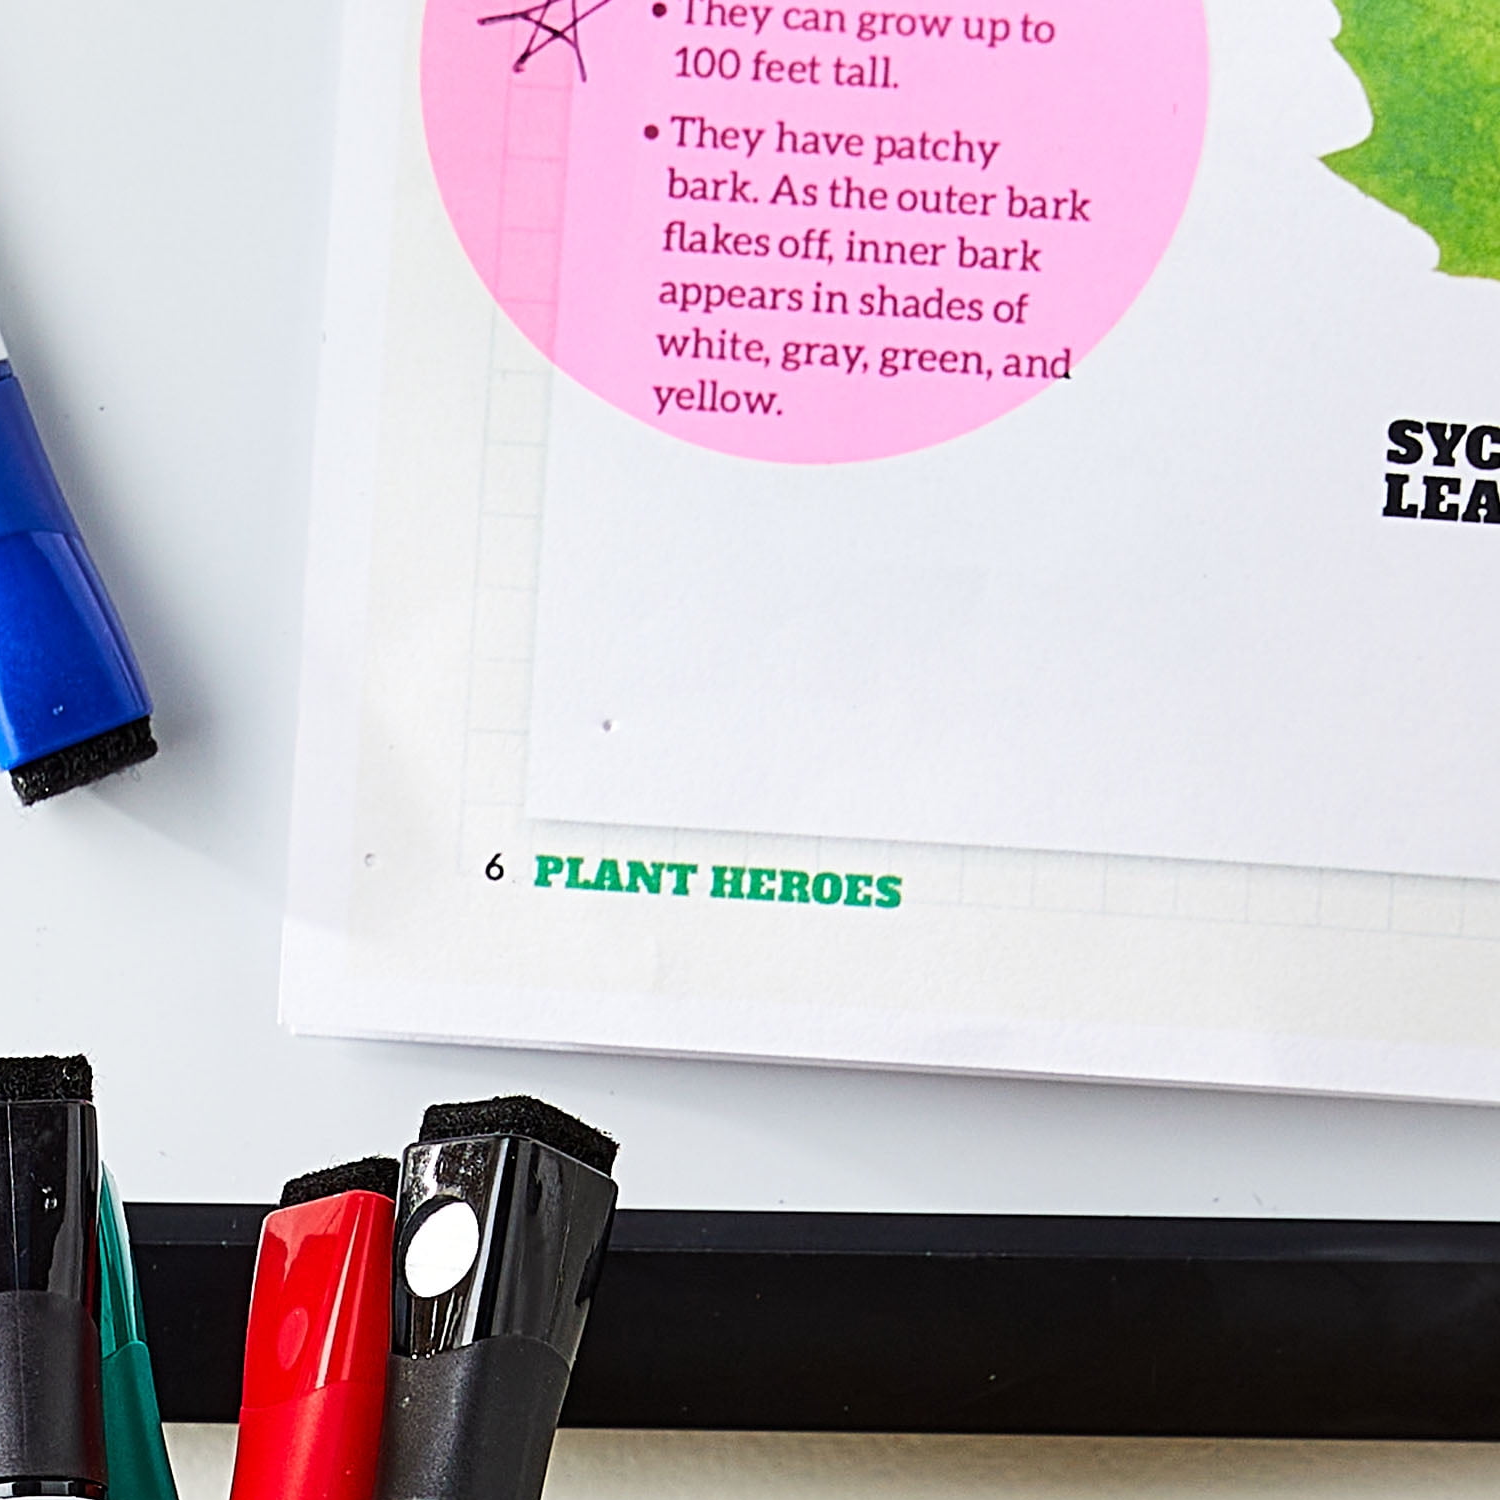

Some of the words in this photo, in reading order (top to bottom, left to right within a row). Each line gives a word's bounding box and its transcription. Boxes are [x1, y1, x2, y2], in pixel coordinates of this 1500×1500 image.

[783, 6, 846, 33] can
[856, 13, 951, 40] grow
[963, 17, 1010, 47] up
[1020, 14, 1056, 44] to
[674, 47, 741, 79] 100
[751, 51, 820, 83] feet
[833, 55, 899, 88] tall.
[671, 116, 764, 158] They
[775, 121, 864, 157] have
[873, 130, 1000, 170] patchy
[667, 168, 759, 203] bark.
[769, 174, 818, 207] As
[828, 177, 888, 211] the
[897, 185, 996, 216] outer
[1006, 186, 1091, 222] bark
[662, 221, 770, 257] flakes
[778, 229, 834, 265] off,
[846, 231, 946, 267] inner
[956, 237, 1042, 272] bark
[659, 282, 803, 312] appears
[811, 282, 848, 315] in
[858, 284, 983, 321] shades
[993, 294, 1030, 324] of
[656, 328, 770, 368] white,
[781, 340, 869, 373] gray,
[879, 345, 992, 379] green,
[1002, 348, 1072, 379] and
[653, 380, 784, 416] yellow.
[1386, 419, 1500, 471] SYC
[1381, 473, 1500, 524] LEA
[484, 852, 505, 881] 6
[533, 854, 698, 897] PLANT
[708, 865, 904, 909] HEROES
